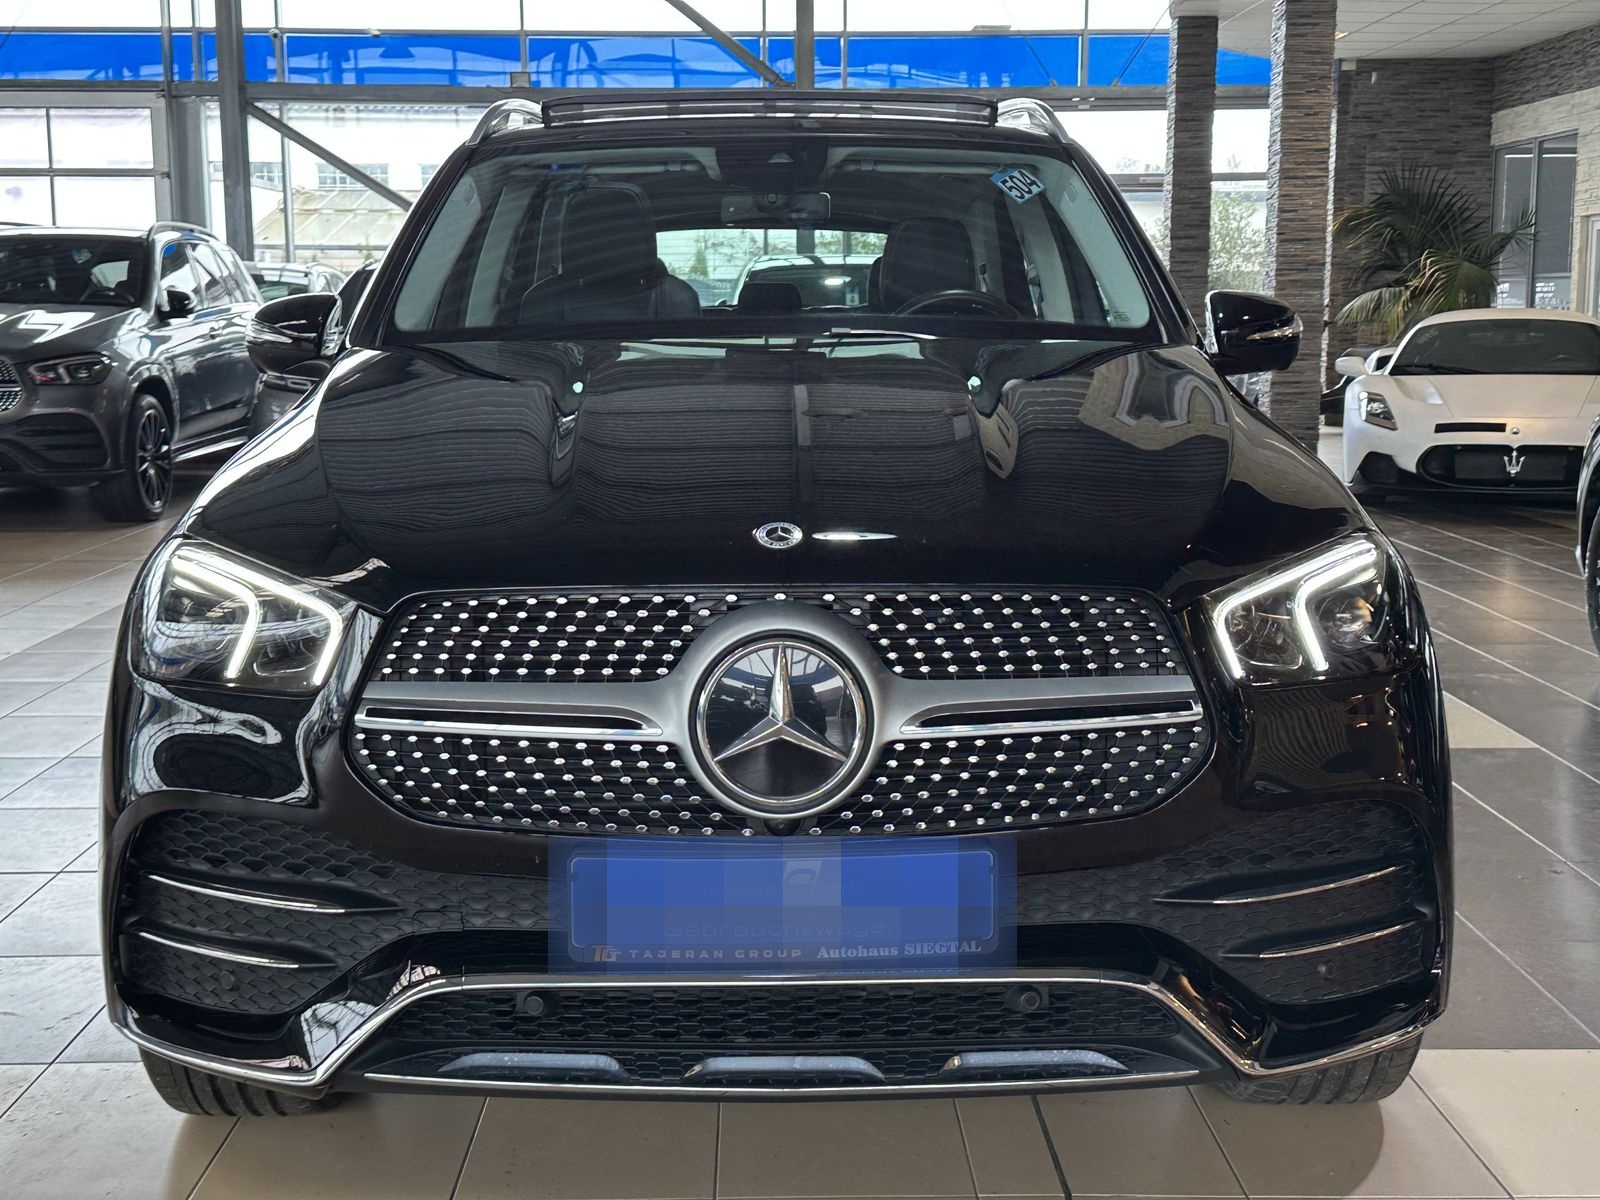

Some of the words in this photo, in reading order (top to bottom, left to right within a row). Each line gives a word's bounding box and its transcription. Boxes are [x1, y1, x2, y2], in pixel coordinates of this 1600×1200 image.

[1000, 170, 1041, 200] 504
[662, 921, 903, 939] Gebrauchtwagen
[629, 949, 724, 959] TAJERAN
[734, 949, 802, 959] GROUP
[816, 945, 899, 959] Autohaus
[904, 940, 982, 955] SIEGTAL
